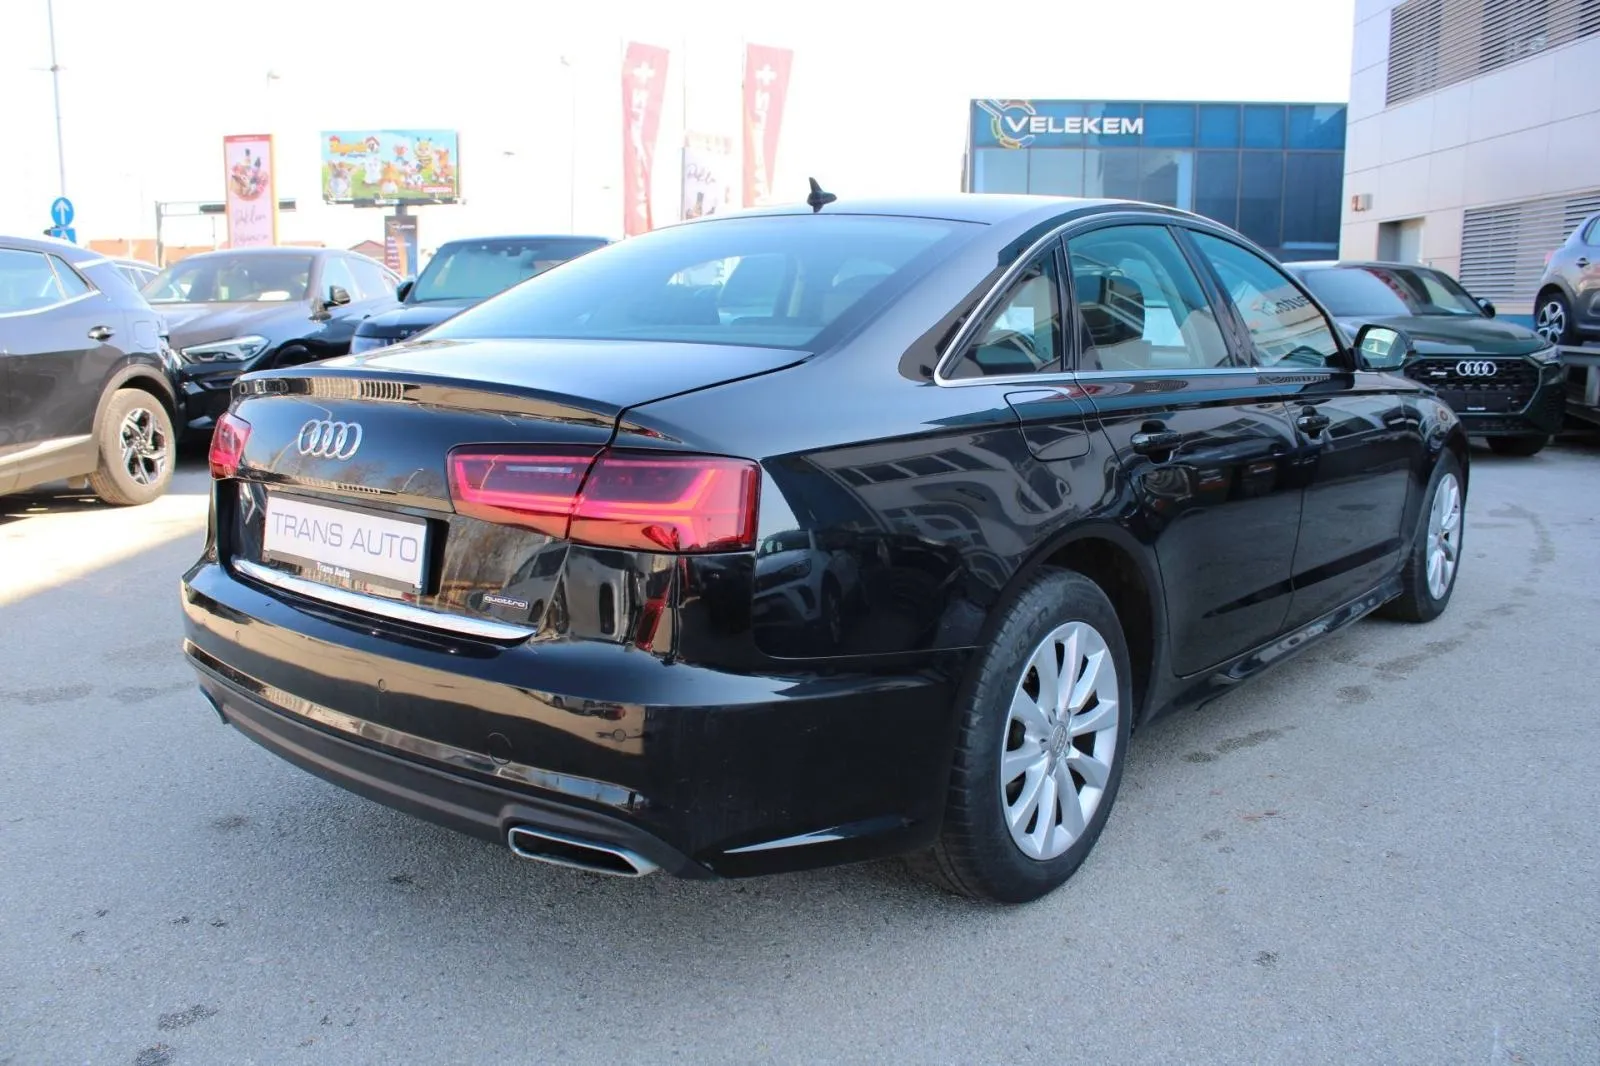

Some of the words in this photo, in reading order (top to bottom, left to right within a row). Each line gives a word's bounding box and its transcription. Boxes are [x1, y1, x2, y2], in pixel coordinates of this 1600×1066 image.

[1005, 116, 1144, 134] VELEKEM
[272, 512, 343, 547] TRANS
[350, 527, 418, 563] AUTO
[484, 596, 525, 607] quattro
